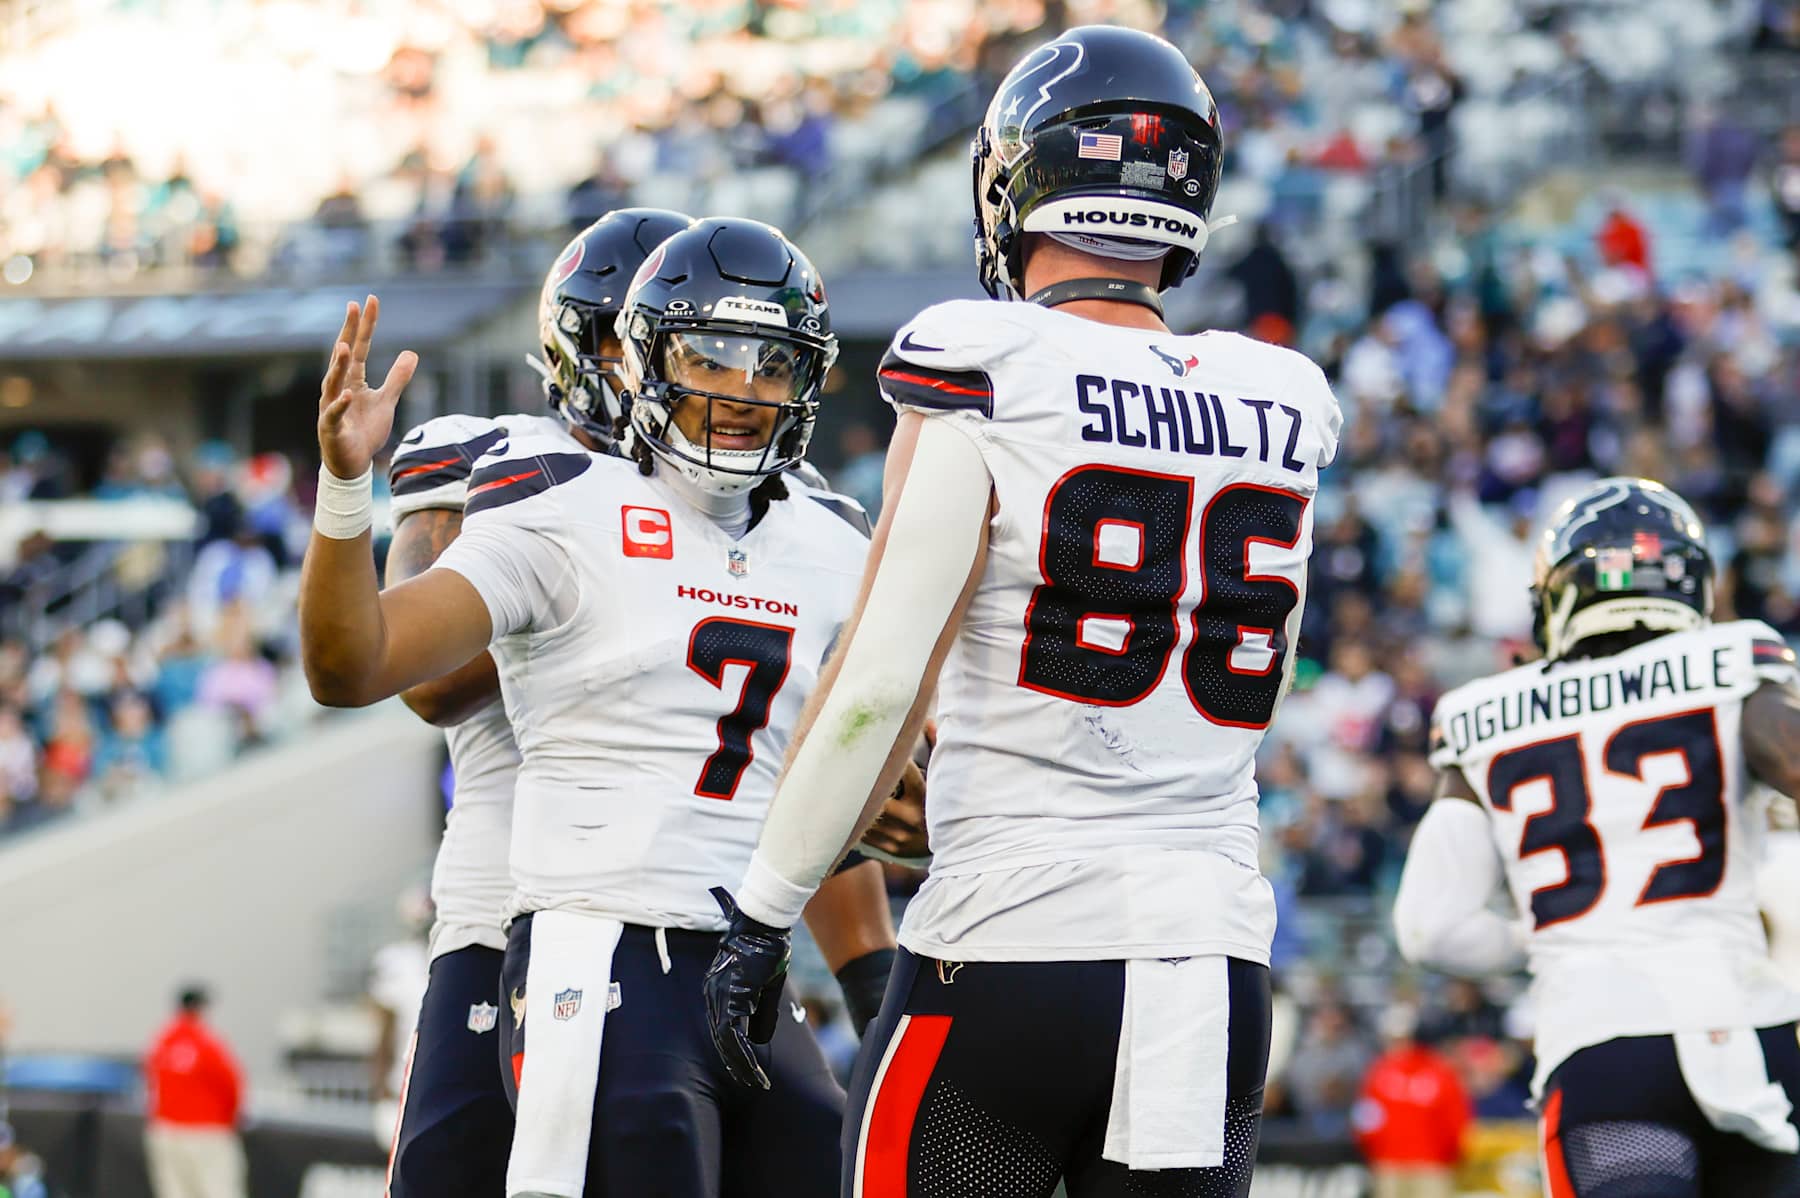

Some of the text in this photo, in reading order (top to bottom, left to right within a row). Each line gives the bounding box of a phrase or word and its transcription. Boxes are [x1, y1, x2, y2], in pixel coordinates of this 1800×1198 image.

[1171, 162, 1185, 175] NFL
[1063, 211, 1198, 239] HOUSTON
[725, 301, 780, 315] TEXANS
[1076, 374, 1305, 473] SCHULTZ
[626, 508, 670, 546] C
[729, 561, 747, 573] NFL
[677, 585, 798, 617] HOUSTON
[1017, 463, 1311, 730] 86
[686, 615, 796, 801] 7
[1450, 648, 1733, 755] OGUNBOWALE
[1488, 706, 1728, 932] 33
[473, 1015, 491, 1025] NFL
[557, 1001, 577, 1018] NFL
